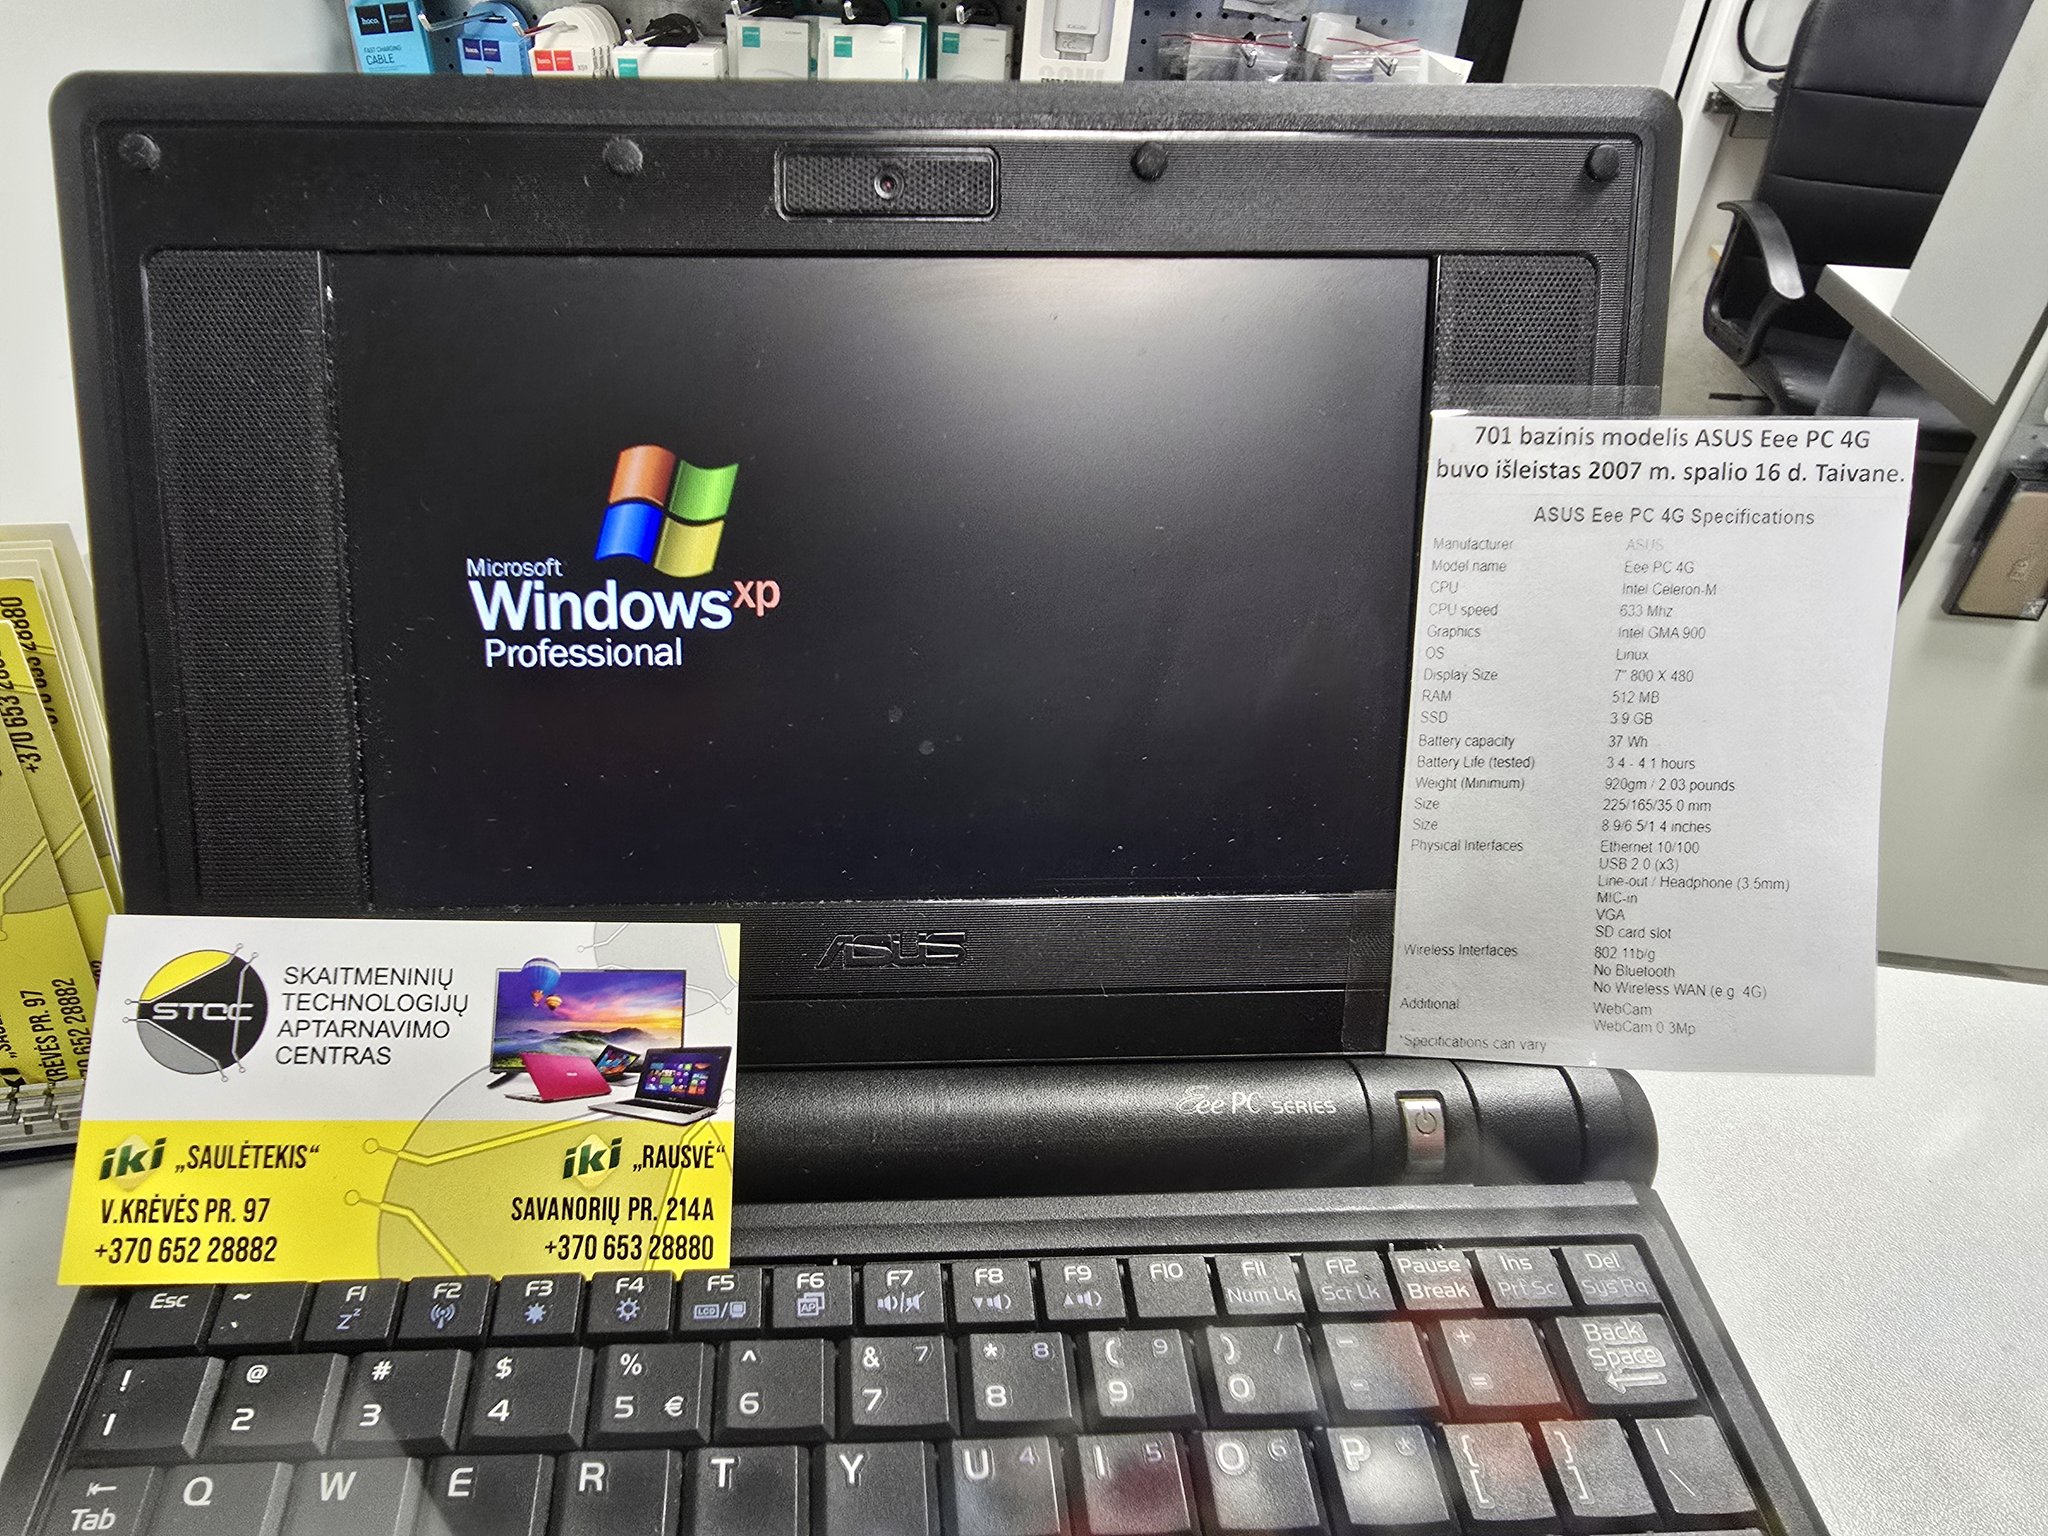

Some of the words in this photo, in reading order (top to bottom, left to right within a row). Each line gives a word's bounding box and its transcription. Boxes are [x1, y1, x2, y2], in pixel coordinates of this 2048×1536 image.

[365, 53, 395, 65] CABLE
[1475, 426, 1512, 446] 701
[1520, 425, 1595, 446] bazinis
[1602, 427, 1688, 447] modelis
[1695, 429, 1753, 447] ASUS
[1761, 429, 1798, 448] Eee
[1806, 430, 1835, 448] PC
[1840, 431, 1871, 449] 4G
[1436, 458, 1489, 479] buvo
[1495, 458, 1581, 480] išleistas
[1588, 461, 1642, 480] 2007
[1649, 465, 1675, 480] m.
[1683, 462, 1748, 485] spalio
[1755, 463, 1781, 481] 16
[1788, 463, 1807, 482] d.
[1816, 463, 1905, 483] Taivane.
[1533, 506, 1585, 523] ASUS
[1591, 507, 1623, 523] Eee
[1630, 507, 1655, 523] PC
[1662, 507, 1684, 523] 4G
[1691, 508, 1815, 527] Specifications
[1432, 537, 1514, 551] Manufacturer
[1625, 538, 1665, 551] ASUS
[466, 556, 564, 578] Microsoft
[1431, 559, 1470, 573] Model
[1472, 561, 1508, 573] name
[1624, 560, 1649, 574] Eee
[1652, 560, 1673, 574] PC
[1676, 560, 1695, 574] 4G
[1430, 580, 1459, 594] CPU
[1622, 583, 1648, 595] Intel
[1652, 582, 1717, 596] Celeron-M
[468, 578, 735, 632] Windows
[733, 579, 781, 617] xp
[1428, 602, 1457, 616] CPU
[1460, 603, 1499, 618] speed
[1619, 604, 1644, 617] 633
[1647, 604, 1673, 617] Mhz
[1427, 624, 1481, 640] Graphics
[1618, 626, 1644, 639] Intel
[1648, 626, 1680, 639] GMA
[1682, 626, 1706, 640] 900
[484, 637, 683, 668] Professional
[1425, 646, 1445, 660] OS
[1616, 648, 1648, 661] Linux
[1423, 667, 1468, 683] Display
[1472, 667, 1499, 681] Size
[1630, 669, 1653, 682] 800
[1670, 669, 1694, 682] 480
[1422, 688, 1452, 702] RAM
[1612, 690, 1635, 703] 512
[1639, 691, 1660, 704] MB
[1420, 710, 1448, 724] SSD
[1634, 712, 1653, 725] GB
[1418, 734, 1461, 750] Battery
[1465, 735, 1515, 750] capacity
[1608, 735, 1623, 748] 37
[1627, 735, 1648, 748] Wh
[1417, 755, 1460, 770] Battery
[1463, 755, 1485, 768] Life
[1488, 756, 1535, 770] (tested)
[1660, 757, 1696, 770] hours
[1415, 777, 1457, 791] Weight
[1460, 777, 1525, 791] (Minimum)
[1605, 777, 1647, 793] 920gm
[1689, 779, 1736, 793] pounds
[1414, 797, 1440, 810] Size
[1688, 801, 1712, 812] mm
[1412, 818, 1438, 831] Size
[1671, 820, 1712, 833] inches
[1410, 838, 1461, 853] Physical
[1464, 839, 1524, 852] Interfaces
[1600, 840, 1653, 853] Ethernet
[1657, 841, 1700, 854] 10/100
[1599, 857, 1627, 870] USB
[1655, 858, 1679, 872] (x3)
[1598, 875, 1649, 888] Line-out
[1660, 876, 1733, 891] Headphone
[1597, 892, 1638, 904] MIC-in
[1596, 908, 1626, 921] VGA
[1595, 925, 1614, 938] SD
[1618, 926, 1645, 939] card
[1650, 926, 1672, 939] slot
[813, 931, 968, 970] ASUS
[1404, 943, 1455, 956] Wireless
[1458, 944, 1519, 957] Interfaces
[283, 965, 454, 989] SKAITMENINIŲ
[1593, 964, 1612, 977] No
[1615, 963, 1676, 978] Bluetooth
[1593, 981, 1612, 994] No
[1615, 981, 1670, 995] Wireless
[1673, 983, 1706, 997] WAN
[1742, 985, 1767, 999] 4G)
[19, 990, 46, 1008] 97
[51, 977, 86, 1026] 28882
[282, 992, 470, 1018] TECHNOLOGIJŲ
[1400, 997, 1460, 1010] Additional
[1593, 1001, 1652, 1015] WebCam
[276, 1019, 450, 1039] APTARNAVIMO
[1593, 1019, 1652, 1033] WebCam
[1492, 1037, 1516, 1050] can
[1520, 1039, 1547, 1054] vary
[275, 1045, 392, 1066] CENTRAS
[1231, 1090, 1263, 1115] PC
[1272, 1100, 1337, 1114] SERIES
[100, 1193, 199, 1223] V.KRĖVĖS
[204, 1199, 237, 1222] PR.
[244, 1198, 271, 1222] 97
[510, 1196, 622, 1226] SAVANORIŲ
[628, 1198, 659, 1222] PR.
[666, 1197, 715, 1222] 214A
[93, 1237, 153, 1264] +370
[157, 1237, 200, 1263] 652
[206, 1236, 278, 1263] 28882
[543, 1236, 598, 1261] +370
[602, 1235, 643, 1260] 653
[649, 1235, 714, 1260] 28880
[1242, 1260, 1268, 1277] F11
[1326, 1258, 1360, 1275] F12
[1399, 1257, 1462, 1276] Pause
[1501, 1254, 1533, 1271] Ins
[1588, 1252, 1621, 1270] Del
[886, 1269, 915, 1287] F7
[975, 1268, 1005, 1286] F8
[1064, 1265, 1093, 1282] F9
[1149, 1262, 1184, 1280] F10
[615, 1277, 645, 1295] F4
[707, 1275, 736, 1293] F5
[796, 1272, 826, 1289] F6
[344, 1286, 367, 1302] F1
[432, 1282, 462, 1300] F2
[524, 1280, 553, 1298] F3
[1228, 1284, 1269, 1302] Num
[1274, 1284, 1298, 1302] Lk
[1321, 1283, 1354, 1301] Scr
[1358, 1283, 1381, 1301] Lk
[1407, 1282, 1470, 1300] Break
[150, 1291, 189, 1310] Esc
[1583, 1321, 1643, 1343] Back
[1588, 1345, 1660, 1370] Space
[70, 1508, 117, 1532] Tab
